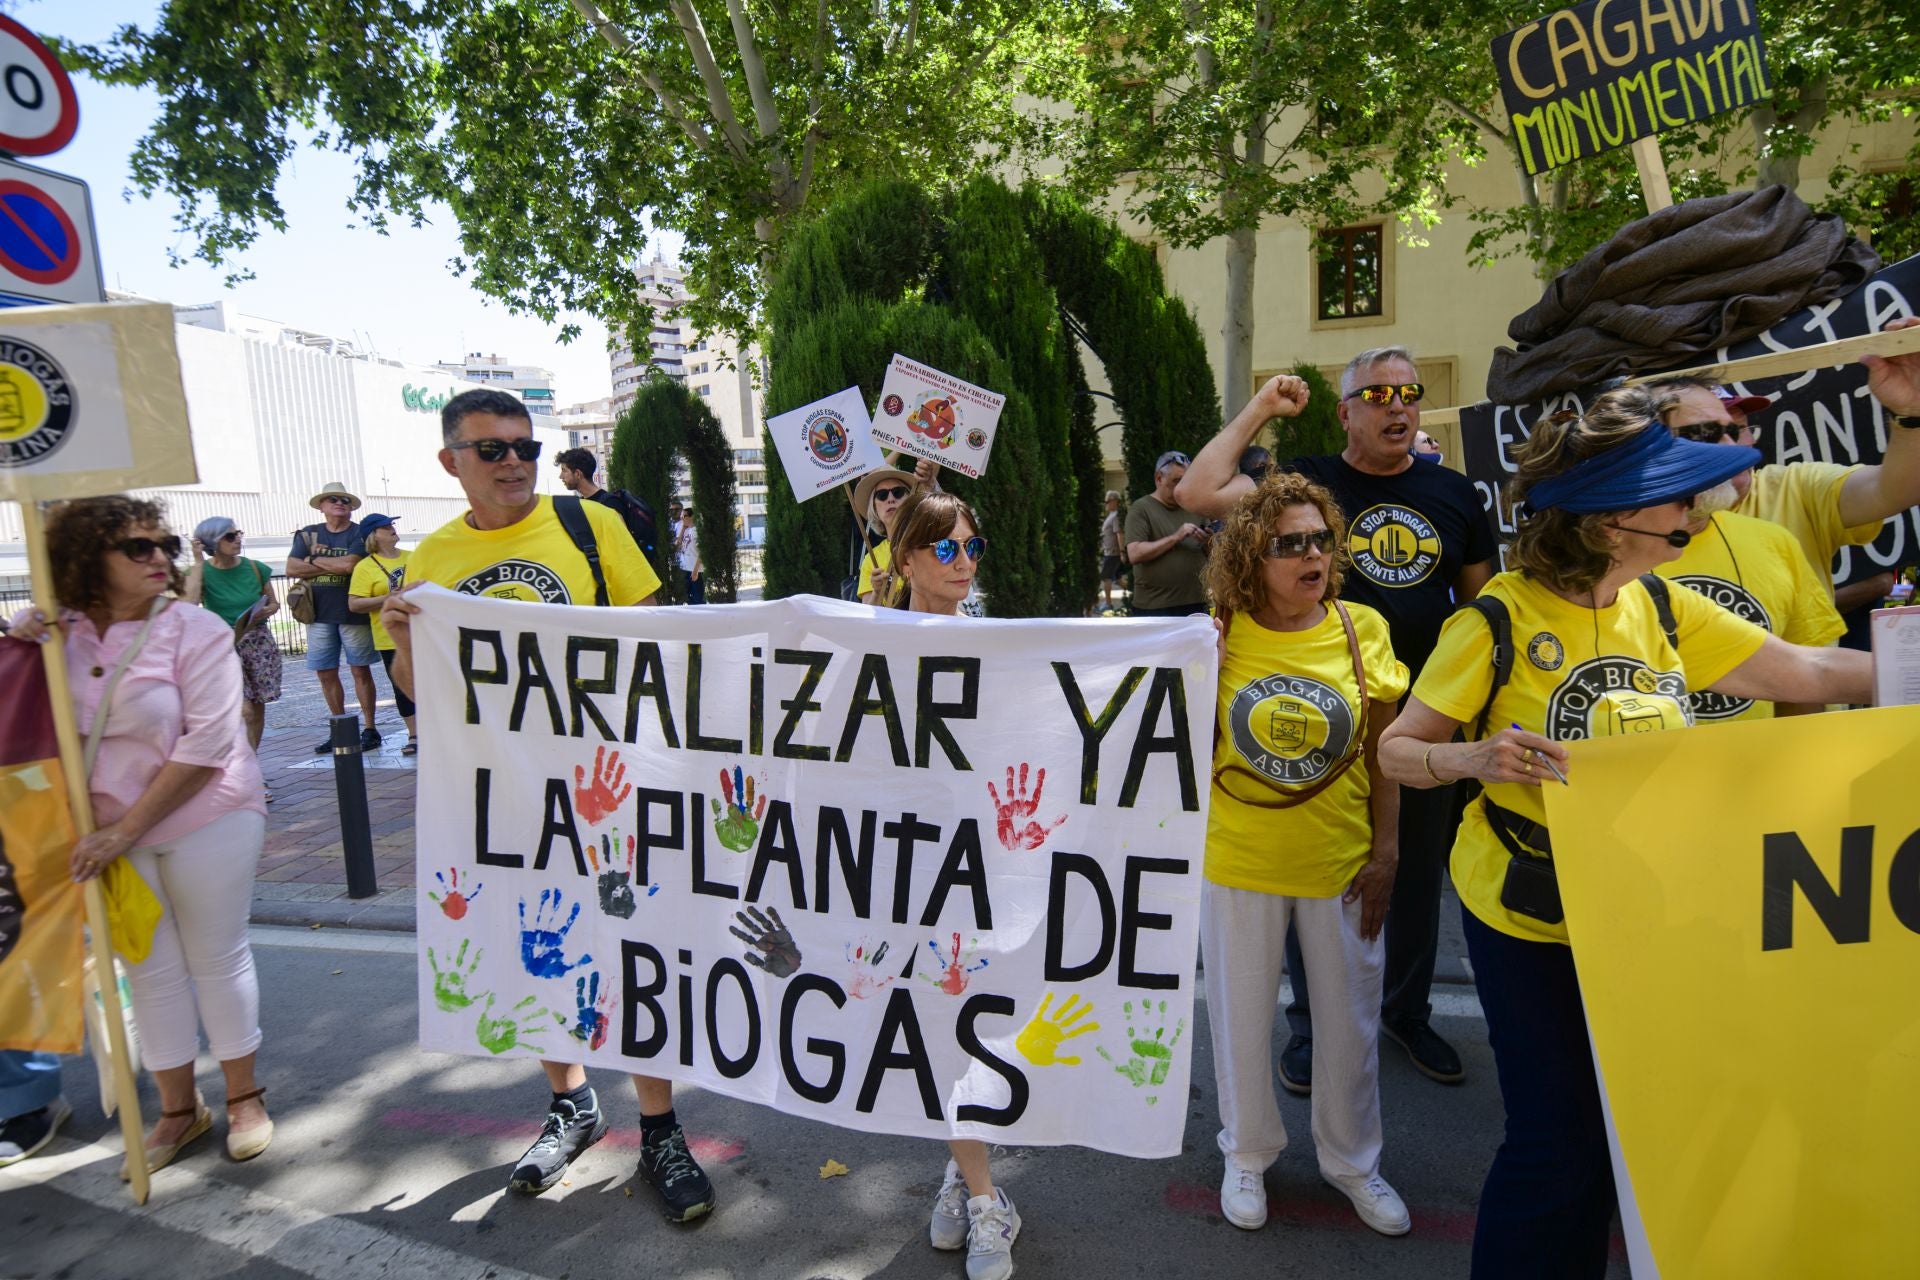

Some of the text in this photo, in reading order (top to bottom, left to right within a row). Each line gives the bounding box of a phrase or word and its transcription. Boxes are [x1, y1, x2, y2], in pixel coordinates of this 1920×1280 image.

[1513, 35, 1772, 175] MONUMENTAL
[968, 387, 1001, 406] CIRCULAR
[498, 565, 563, 604] BIOGÁ
[1357, 552, 1432, 582] FUENTE ÁLAMO
[1050, 661, 1200, 812] YA
[1253, 752, 1326, 778] ASÍ NO
[475, 767, 1190, 990] LA PLANTA DE
